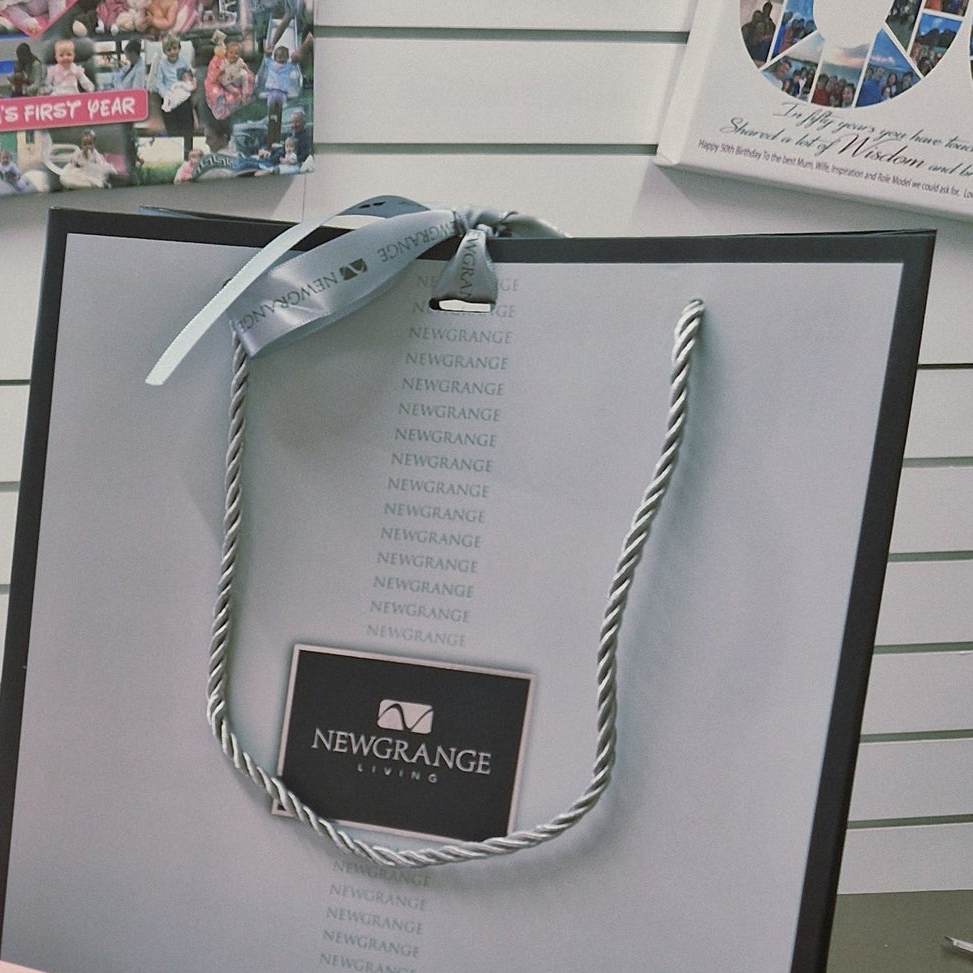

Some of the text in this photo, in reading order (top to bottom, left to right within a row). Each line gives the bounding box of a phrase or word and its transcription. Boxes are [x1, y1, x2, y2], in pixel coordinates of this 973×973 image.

[25, 101, 85, 124] FIRST
[87, 96, 136, 119] YEAR
[773, 101, 802, 118] In
[830, 121, 875, 134] years
[873, 129, 907, 142] you
[909, 129, 942, 145] have
[719, 117, 786, 140] Shared
[795, 133, 822, 147] lot
[813, 137, 842, 158] of
[835, 133, 925, 168] Wisdom
[928, 163, 964, 175] and
[698, 139, 719, 153] Happy
[720, 143, 736, 155] 50th
[735, 146, 762, 160] Birthday
[770, 153, 782, 164] the
[782, 156, 797, 165] best
[830, 163, 865, 178] Inspiration
[864, 172, 878, 182] and
[878, 172, 892, 184] Role
[892, 175, 912, 188] Model
[911, 180, 922, 188] we
[922, 181, 940, 194] could
[939, 184, 950, 195] ask
[237, 271, 345, 333] NEWGRANGE
[409, 326, 512, 345] NEWGRANGE
[405, 352, 508, 371] NEWGRANGE
[402, 377, 504, 396] NEWGRANGE
[398, 402, 501, 422] NEWGRANGE
[394, 428, 497, 448] NEWGRANGE
[391, 453, 493, 473] NEWGRANGE
[387, 477, 489, 497] NEWGRANGE
[384, 502, 485, 523] NEWGRANGE
[380, 527, 481, 548] NEWGRANGE
[376, 551, 478, 573] NEWGRANGE
[373, 576, 474, 598] NEWGRANGE
[370, 600, 471, 623] NEWGRANGE
[366, 624, 467, 647] NEWGRANGE
[311, 728, 492, 775] NEWGRANGE
[358, 764, 438, 783] LIVING
[332, 860, 431, 887] NEWGRANGE
[329, 884, 427, 911] NEWGRANGE
[326, 907, 424, 935] NEWGRANGE
[323, 930, 420, 957] NEWGRANGE
